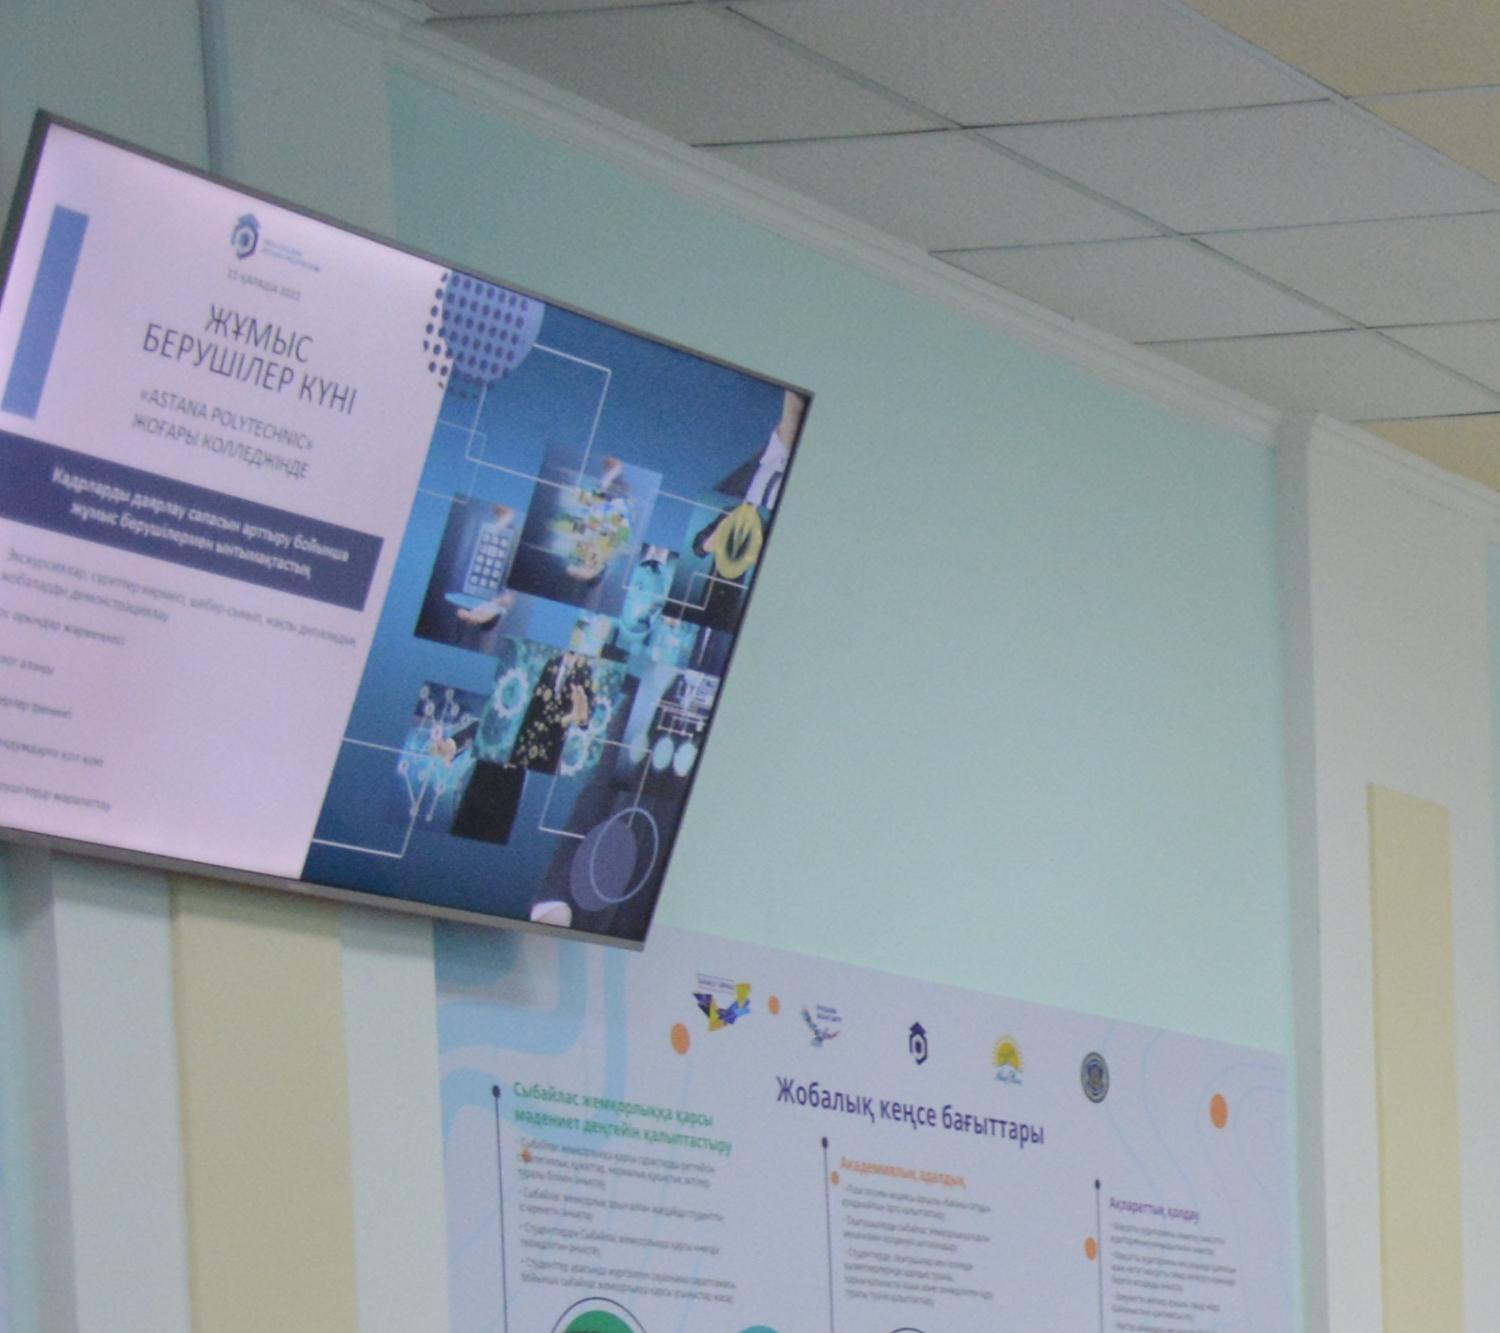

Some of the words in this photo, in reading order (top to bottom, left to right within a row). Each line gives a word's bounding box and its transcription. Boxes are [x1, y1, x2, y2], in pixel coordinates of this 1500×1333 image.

[205, 304, 313, 363] ЖҰМЫС
[143, 322, 294, 393] БЕРУШІЛЕР
[300, 373, 357, 415] КҮНІ
[132, 413, 200, 448] ЖОҒАРЫ
[140, 387, 208, 420] «ASTANA
[210, 405, 314, 451] POLYTECHNIC»
[776, 1076, 876, 1123] Жобалық
[880, 1100, 937, 1130] кеңсе
[942, 1106, 1045, 1148] бағыттары
